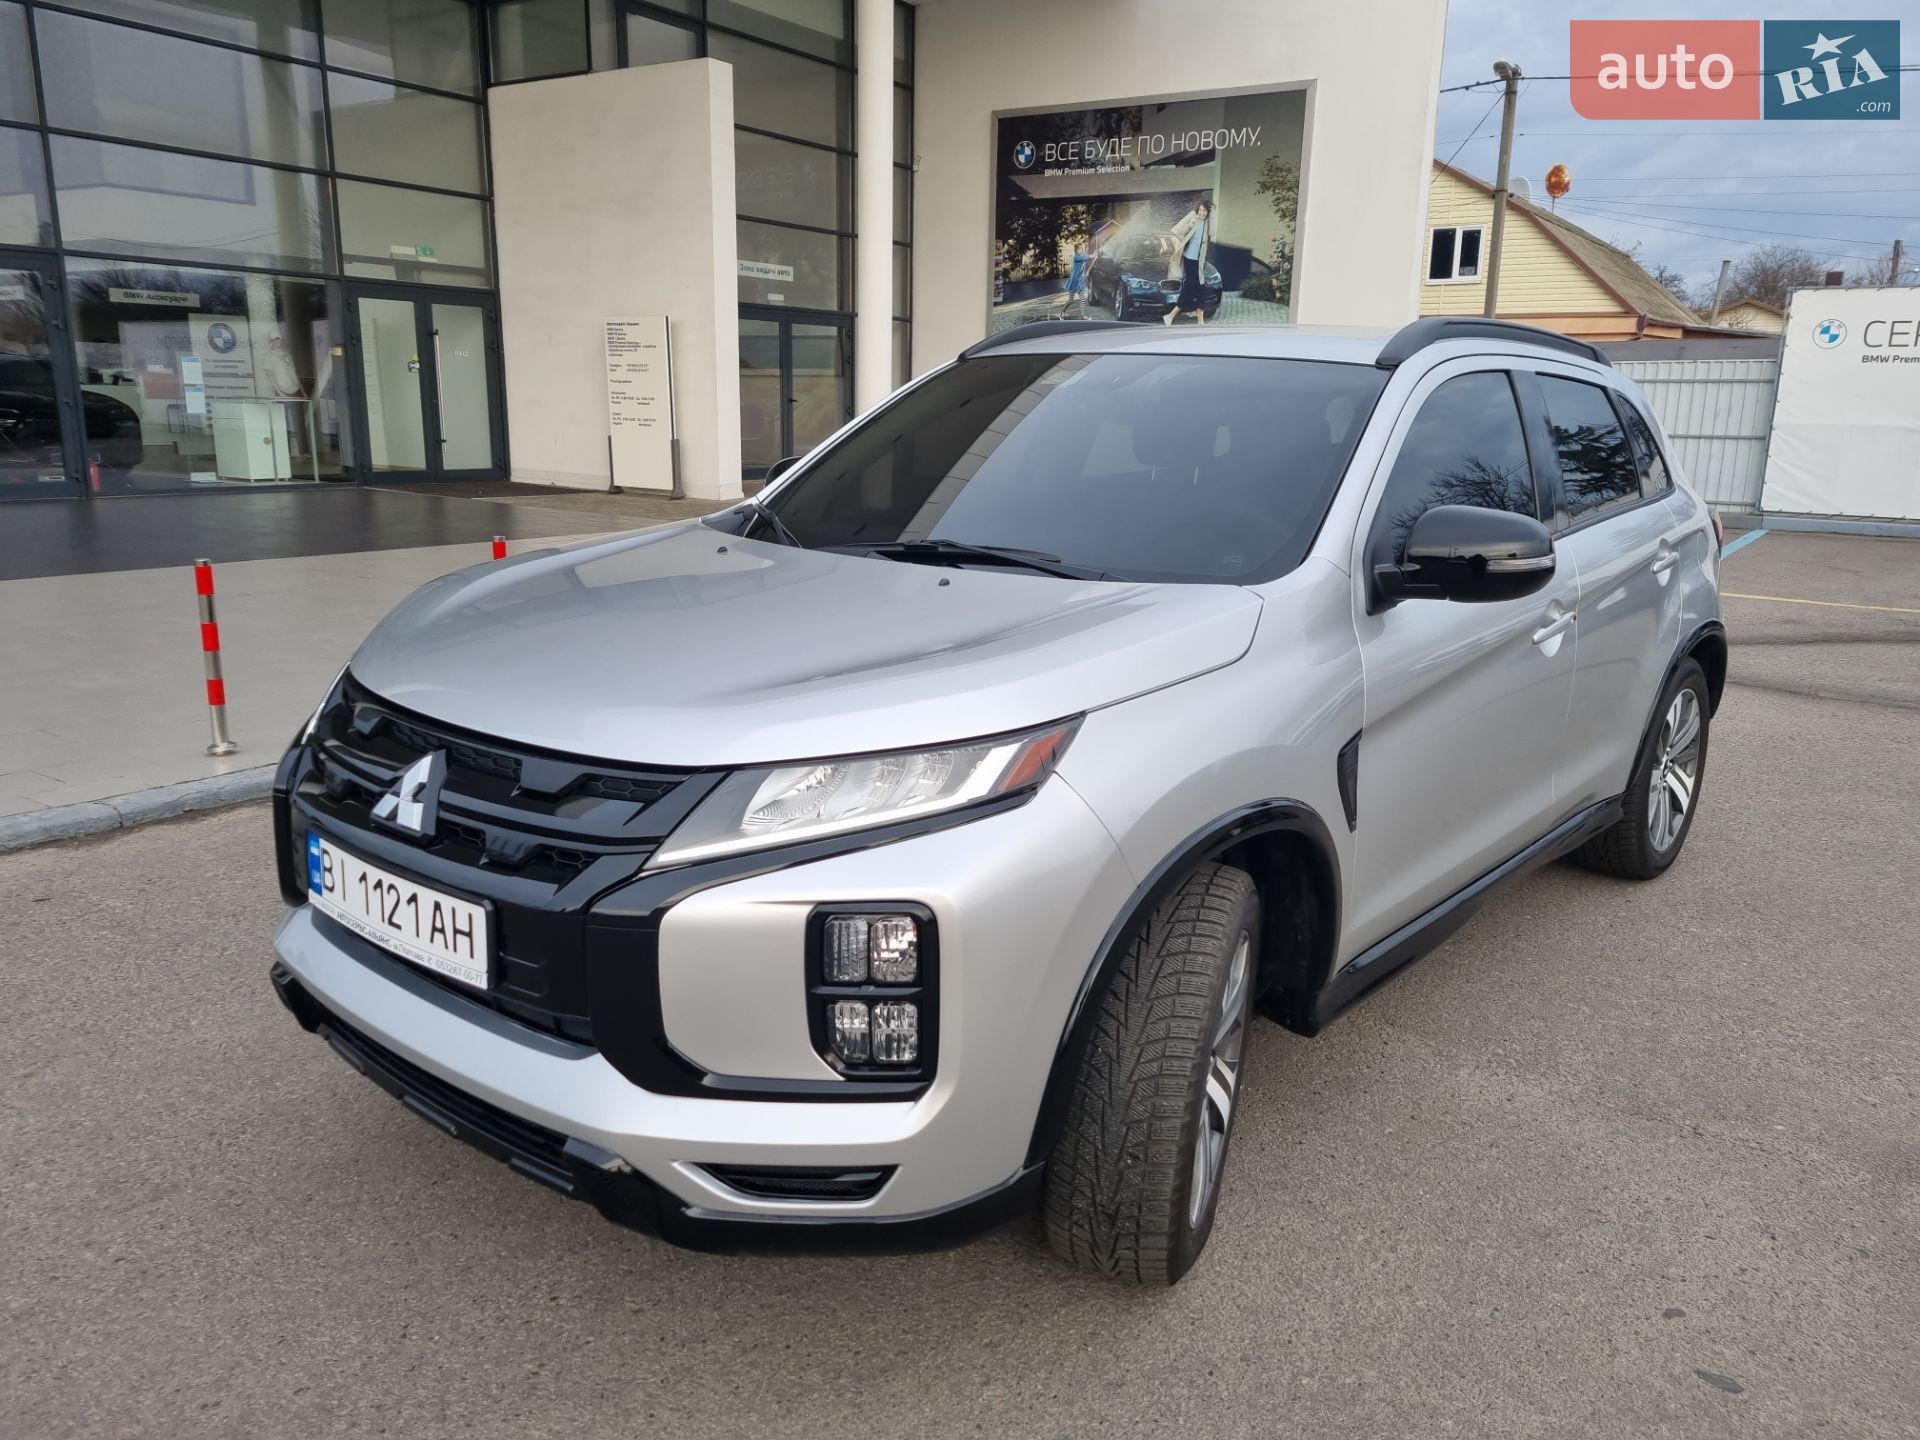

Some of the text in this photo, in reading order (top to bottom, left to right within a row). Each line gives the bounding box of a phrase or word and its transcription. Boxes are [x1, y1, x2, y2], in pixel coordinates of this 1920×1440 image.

[1045, 141, 1079, 162] ВСЕ
[1085, 137, 1132, 159] БУДЕ
[1138, 134, 1164, 156] ПО
[1171, 126, 1261, 152] НОВОМУ.
[1044, 164, 1130, 177] BMW Premium Selection
[123, 291, 143, 299] BMW
[1861, 354, 1920, 363] BMW Prem
[322, 847, 346, 902] BI
[358, 871, 420, 938] 1121
[430, 900, 474, 959] AH
